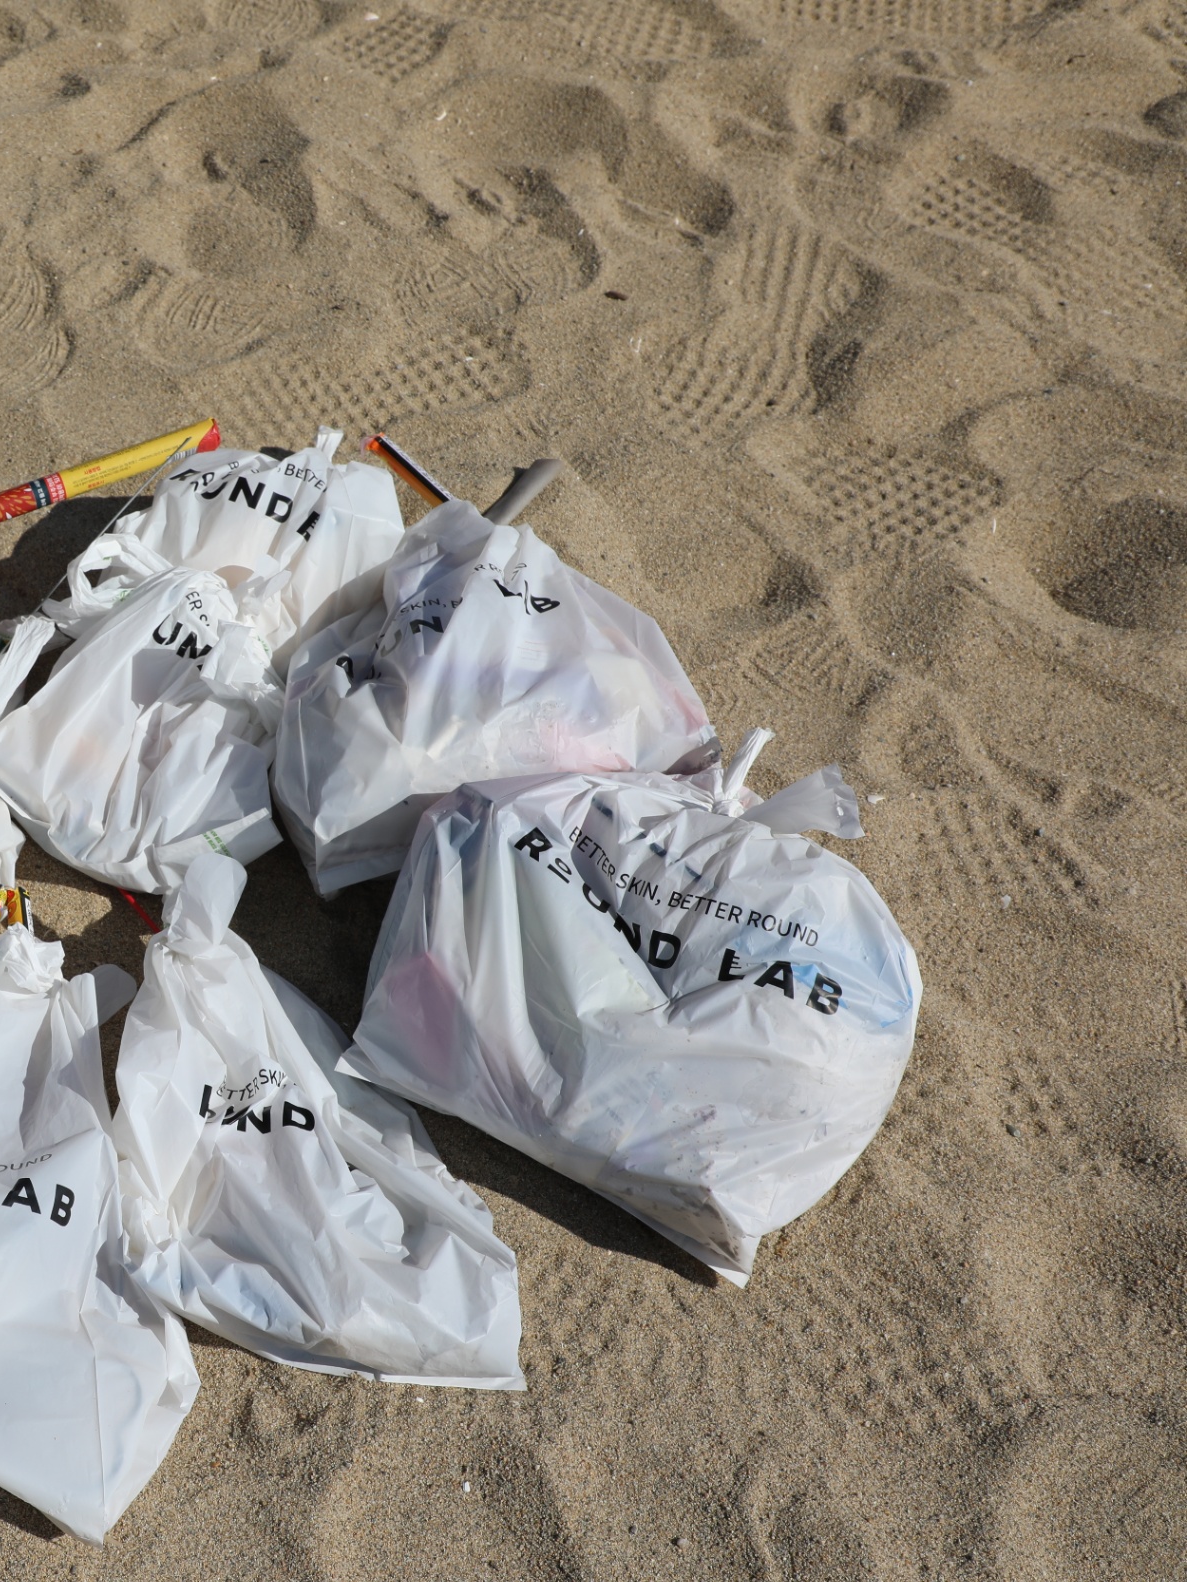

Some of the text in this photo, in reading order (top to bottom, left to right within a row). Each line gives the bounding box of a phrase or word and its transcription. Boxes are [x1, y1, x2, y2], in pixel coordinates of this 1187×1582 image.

[568, 825, 820, 947] BETTER SKIN, BETTER ROUND
[717, 947, 844, 1016] LAB
